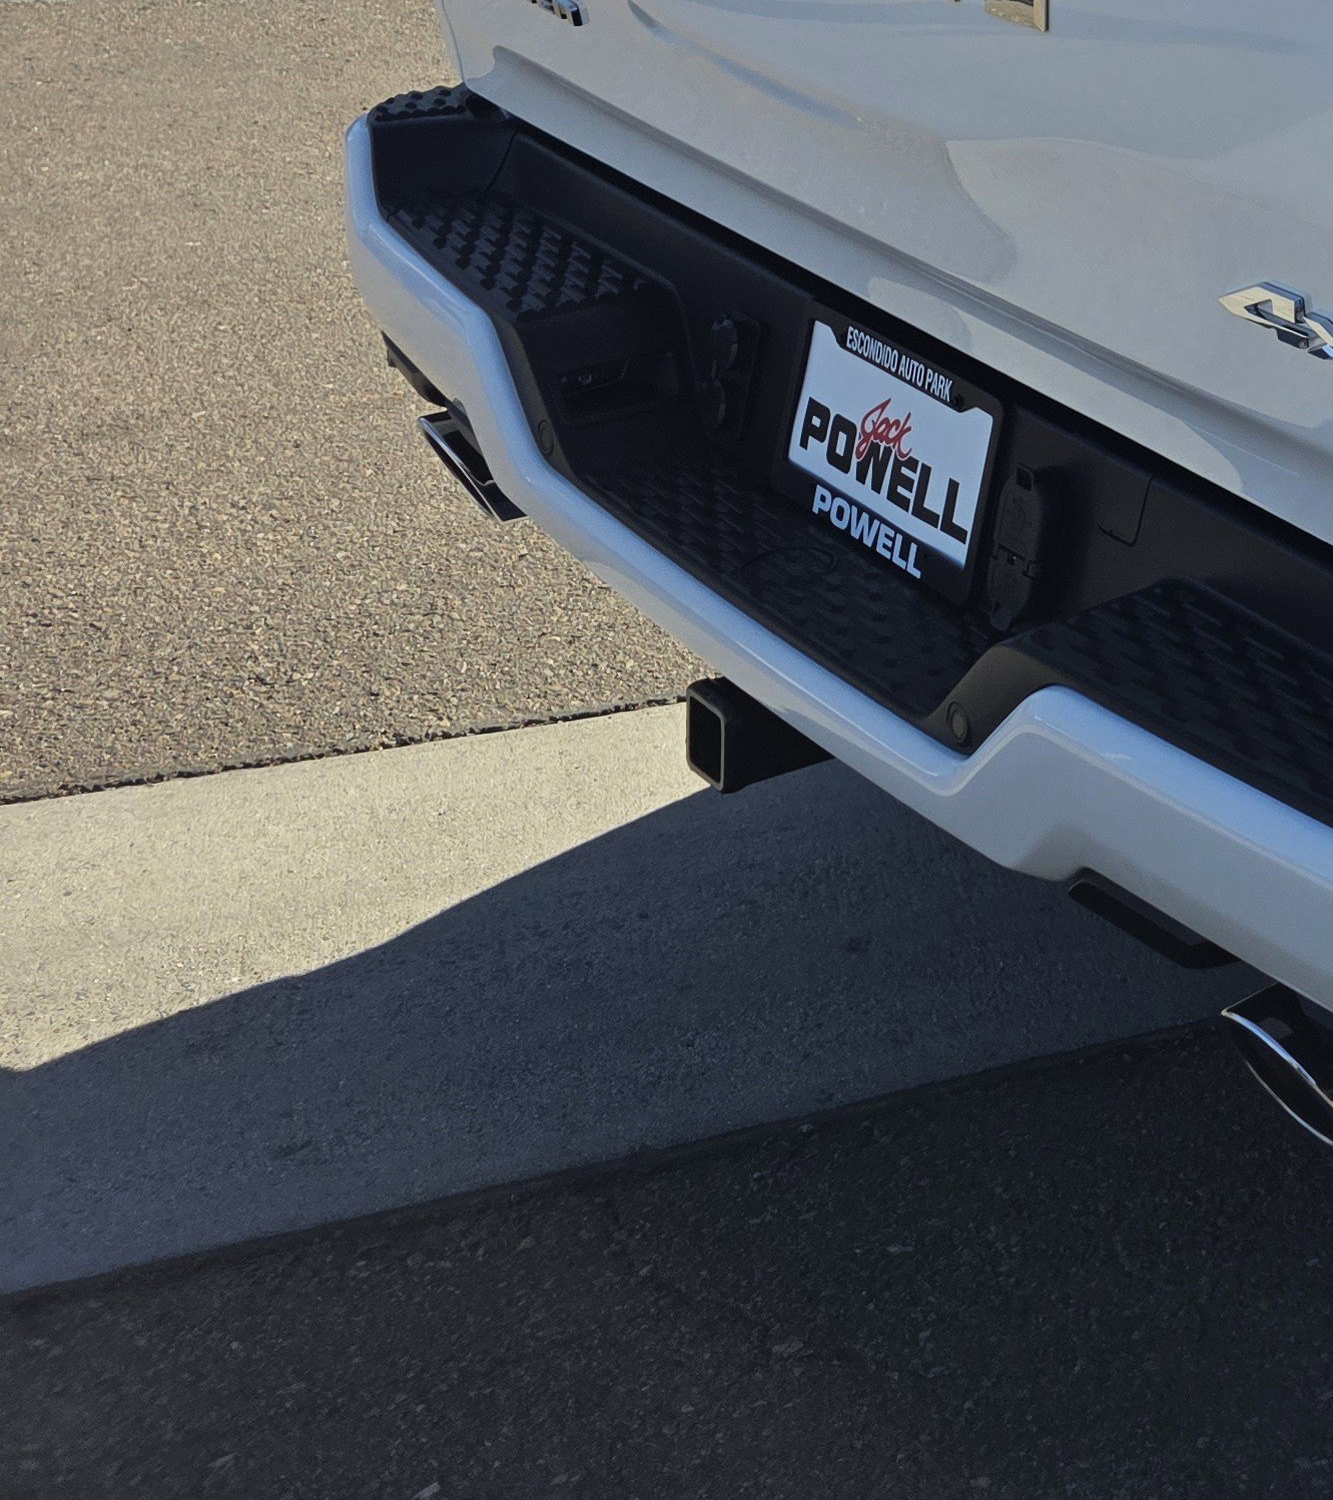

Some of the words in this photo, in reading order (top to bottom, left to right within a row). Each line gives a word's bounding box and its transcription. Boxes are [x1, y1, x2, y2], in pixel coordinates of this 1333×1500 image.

[846, 325, 899, 373] ESCONDIDO
[898, 354, 925, 388] AUTO
[925, 368, 953, 402] PARK
[799, 396, 968, 545] POWELL
[855, 397, 913, 460] Jack
[811, 484, 922, 579] POWELL
